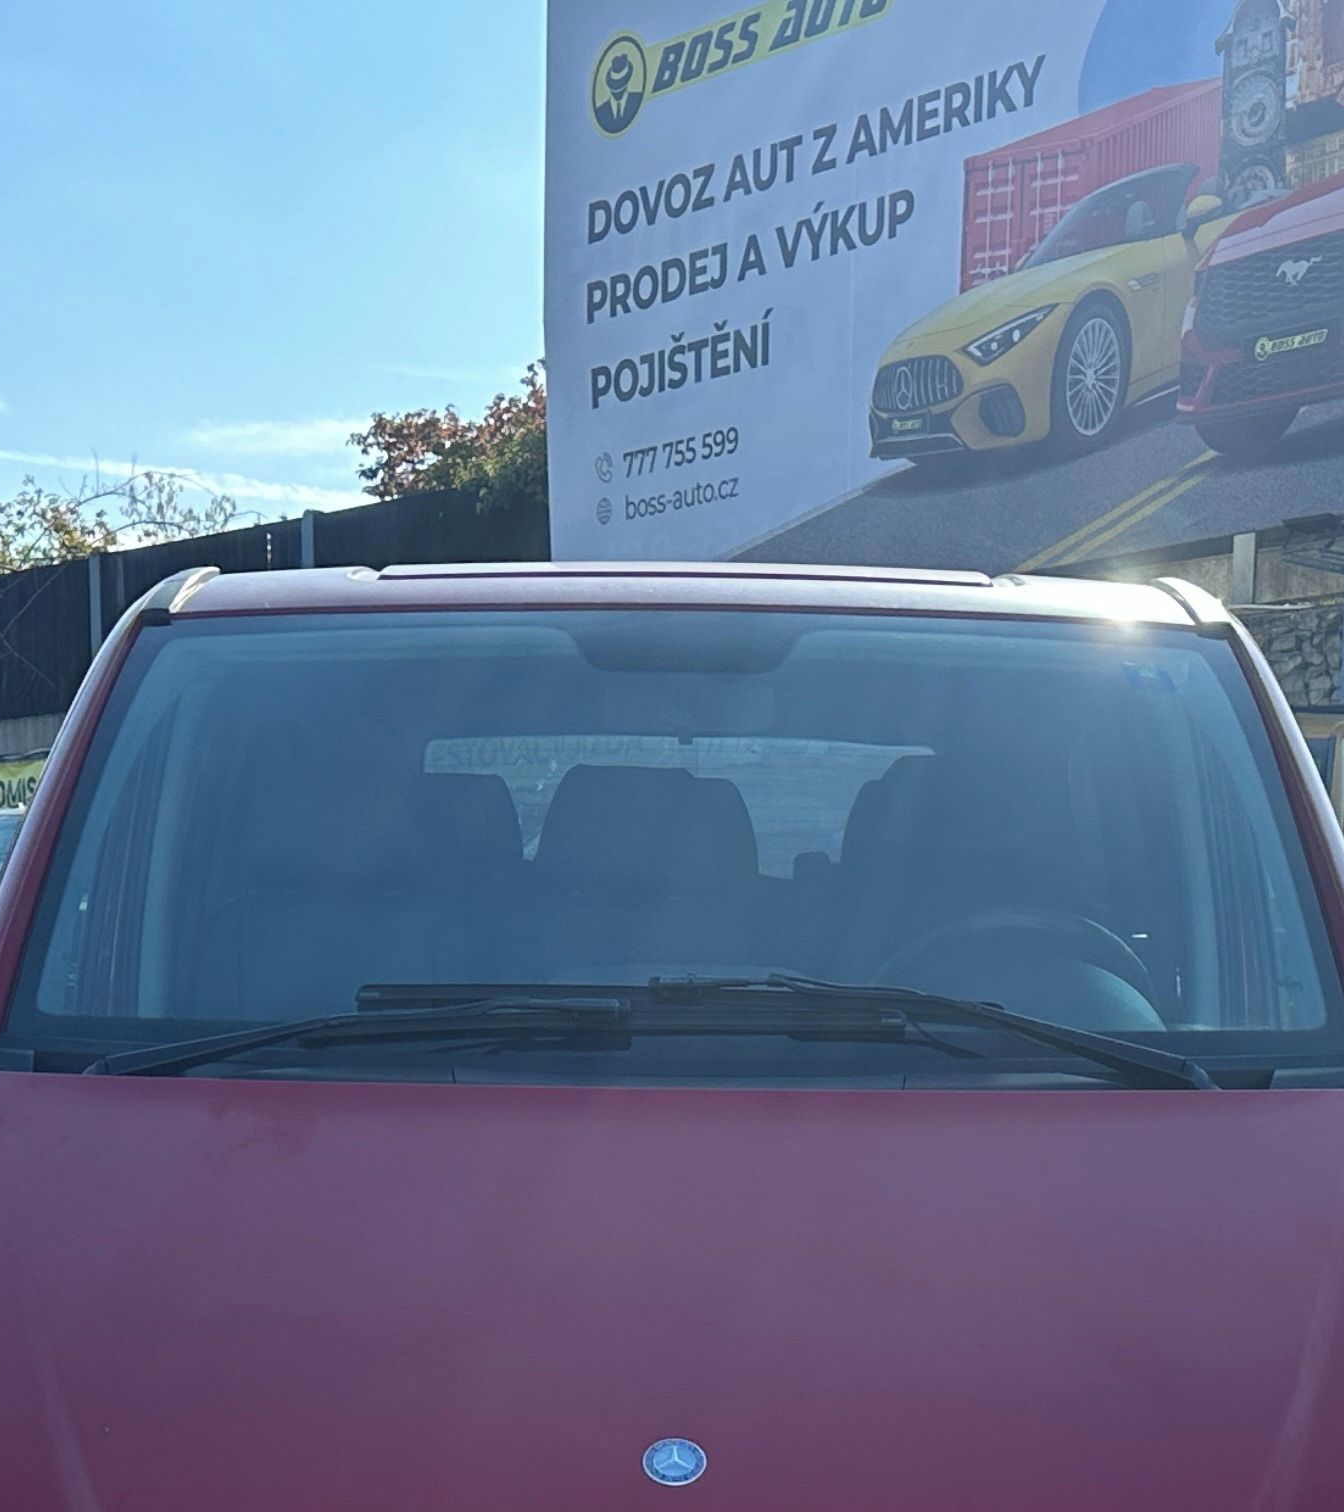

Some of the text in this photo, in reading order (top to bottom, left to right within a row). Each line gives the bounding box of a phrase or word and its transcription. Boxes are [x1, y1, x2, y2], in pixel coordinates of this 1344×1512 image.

[652, 12, 761, 93] BOSS
[588, 54, 1047, 244] DOVOZ AUT Z AMERIKY
[586, 189, 914, 324] PRODEJ A VÝKUP
[591, 307, 774, 409] POJIŠTĚNÍ
[623, 427, 739, 478] 777 755 599
[625, 477, 739, 520] boss-auto.cz
